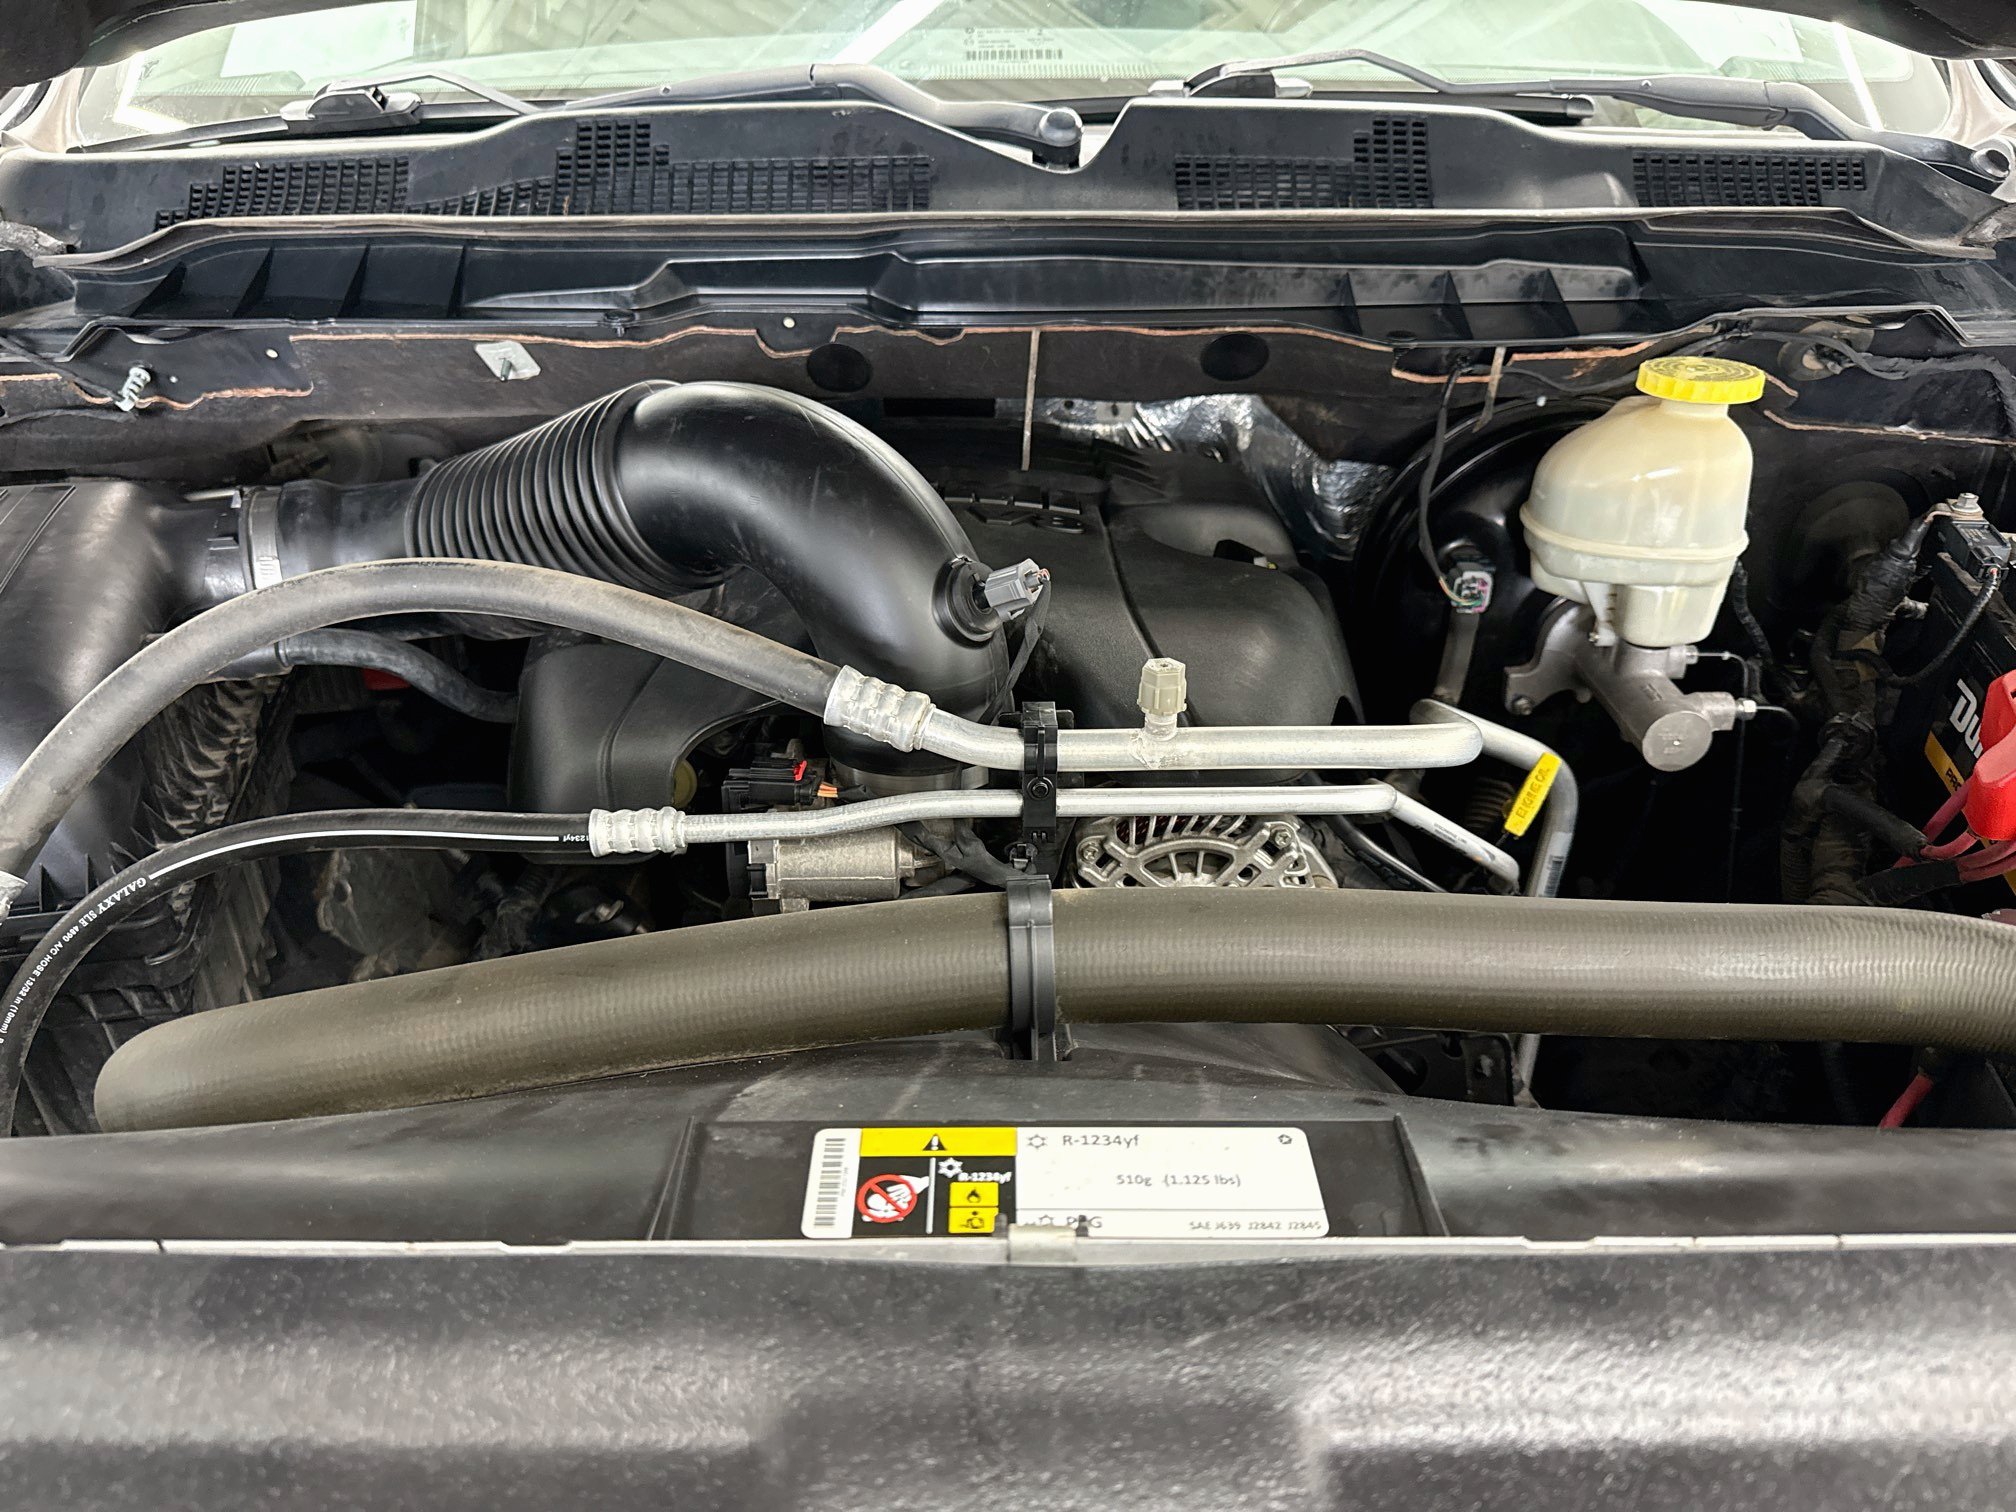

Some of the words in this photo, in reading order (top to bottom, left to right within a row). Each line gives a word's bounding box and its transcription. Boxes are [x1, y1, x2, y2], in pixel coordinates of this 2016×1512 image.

[97, 877, 147, 914] GALAXY
[50, 941, 64, 956] A/C
[32, 954, 53, 977] HOSE
[19, 976, 36, 997] 13/32
[1062, 1134, 1139, 1148] R-1234yf
[1116, 1174, 1153, 1187] 510g
[1163, 1174, 1210, 1188] (1.125
[1213, 1174, 1241, 1188] lbs)
[1066, 1215, 1103, 1229] PG
